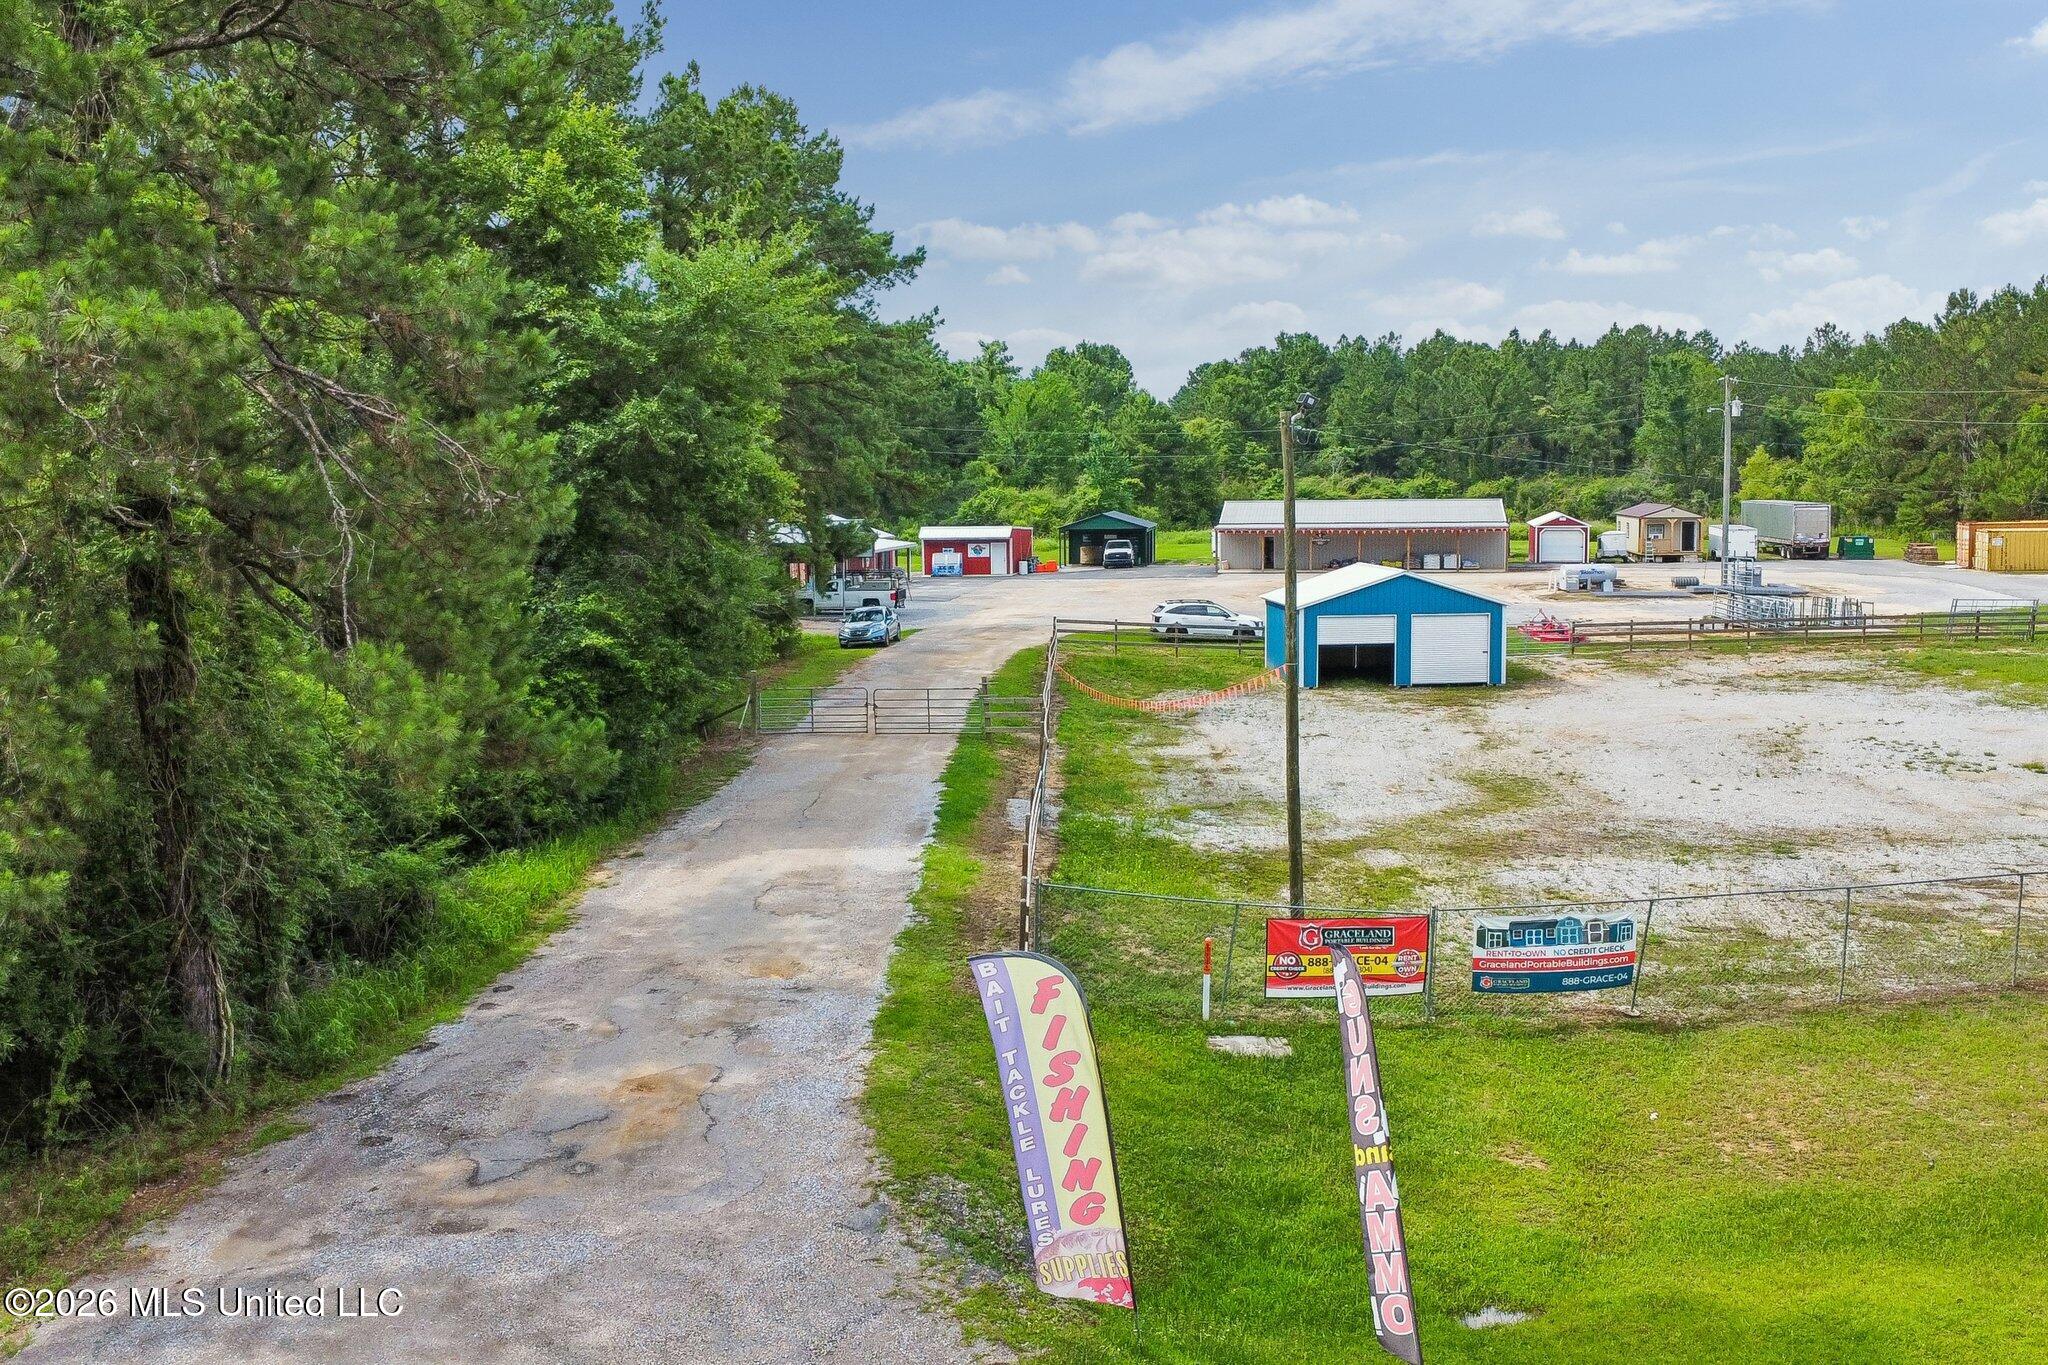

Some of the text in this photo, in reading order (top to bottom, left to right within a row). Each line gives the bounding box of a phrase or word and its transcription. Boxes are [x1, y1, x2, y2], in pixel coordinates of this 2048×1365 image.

[1303, 928, 1318, 948] G
[1324, 929, 1392, 939] GRACELAND
[1567, 947, 1597, 955] CREDIT
[1598, 945, 1626, 953] CHECK
[1279, 956, 1296, 965] NO
[1307, 956, 1388, 967] 888-CE-04
[1479, 955, 1629, 969] GracelandPortableBuildings.com
[1562, 972, 1628, 986] 888-GRACE-04
[976, 961, 1054, 1247] BAIT TACKLE LURES
[1030, 975, 1106, 1226] FISHING
[1039, 1250, 1130, 1286] SUPPLIES
